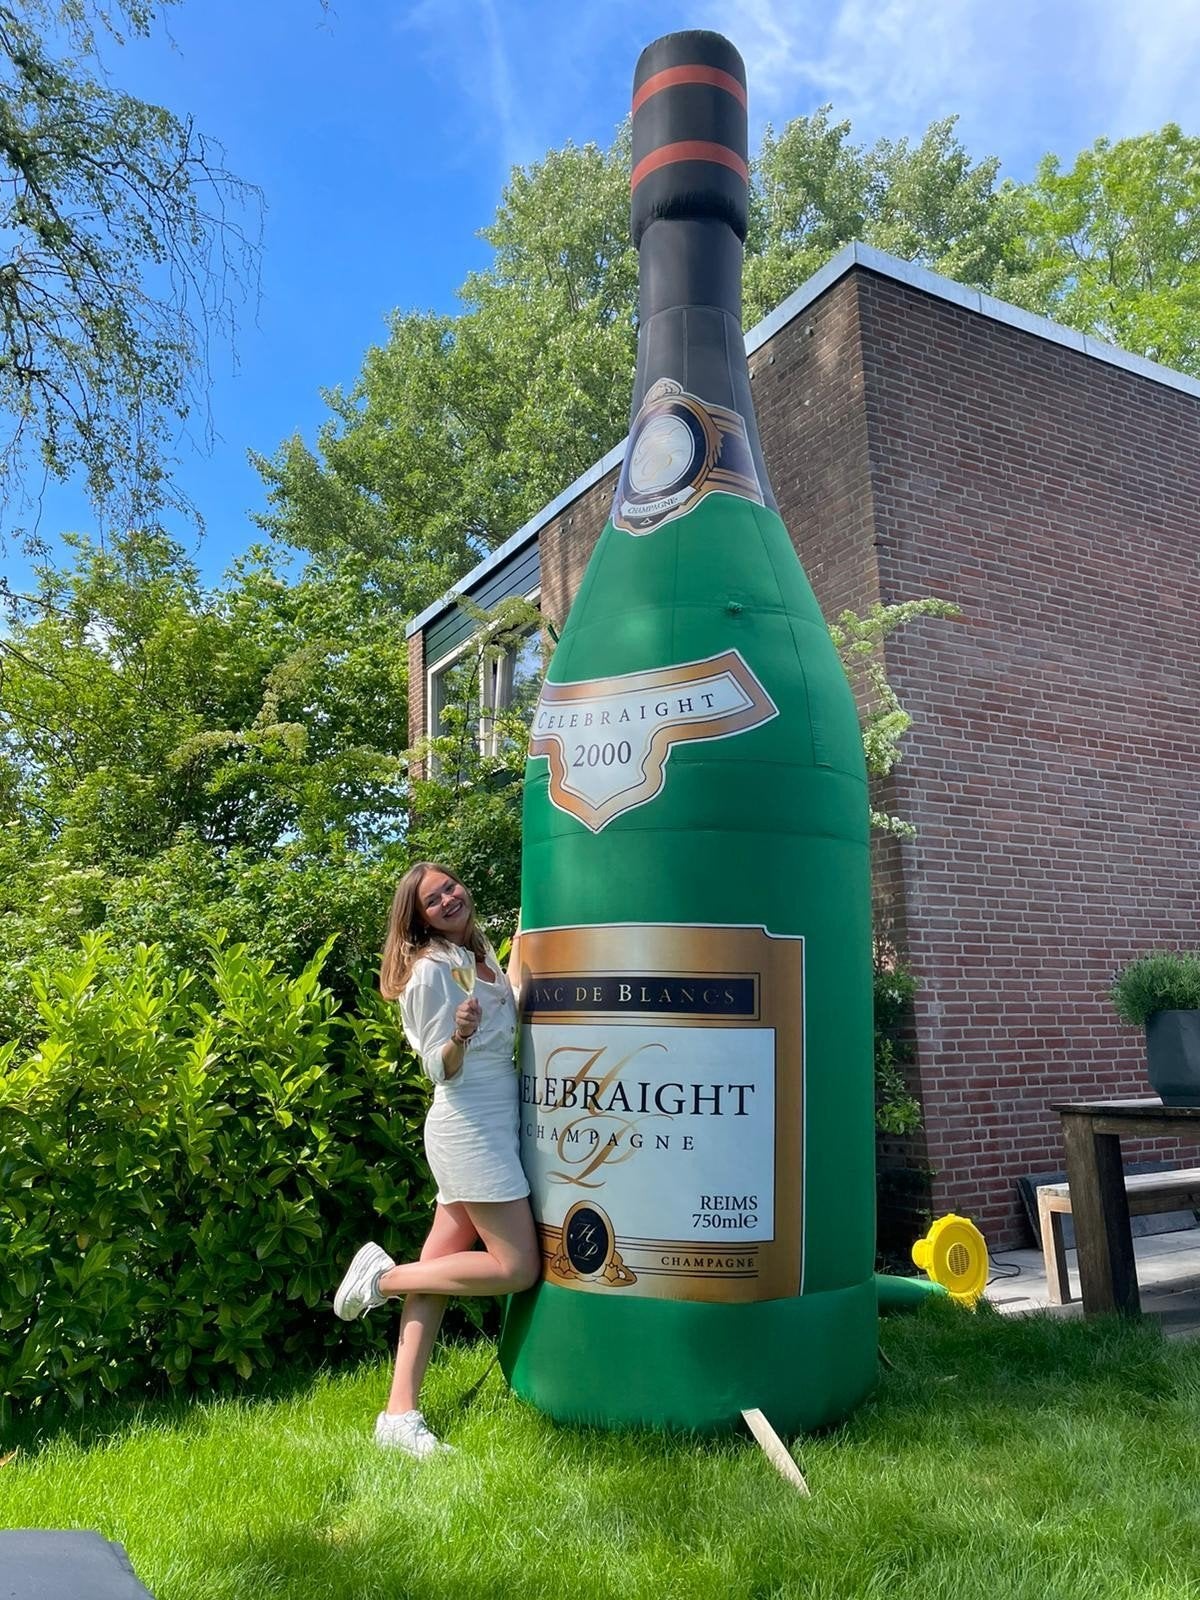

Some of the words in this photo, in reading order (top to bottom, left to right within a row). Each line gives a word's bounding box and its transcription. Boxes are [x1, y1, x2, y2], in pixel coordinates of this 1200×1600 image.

[627, 497, 679, 514] CHAMPAGNE
[537, 693, 714, 729] CELEBRAIGHT
[572, 740, 632, 767] 2000
[575, 986, 603, 1002] DE
[619, 984, 735, 1004] BLANCS
[520, 1074, 755, 1116] ELEBRAIGHT
[526, 1122, 695, 1151] CHAMPAGNE
[700, 1195, 758, 1211] REIMS
[661, 1256, 755, 1268] CHAMPAGNE
